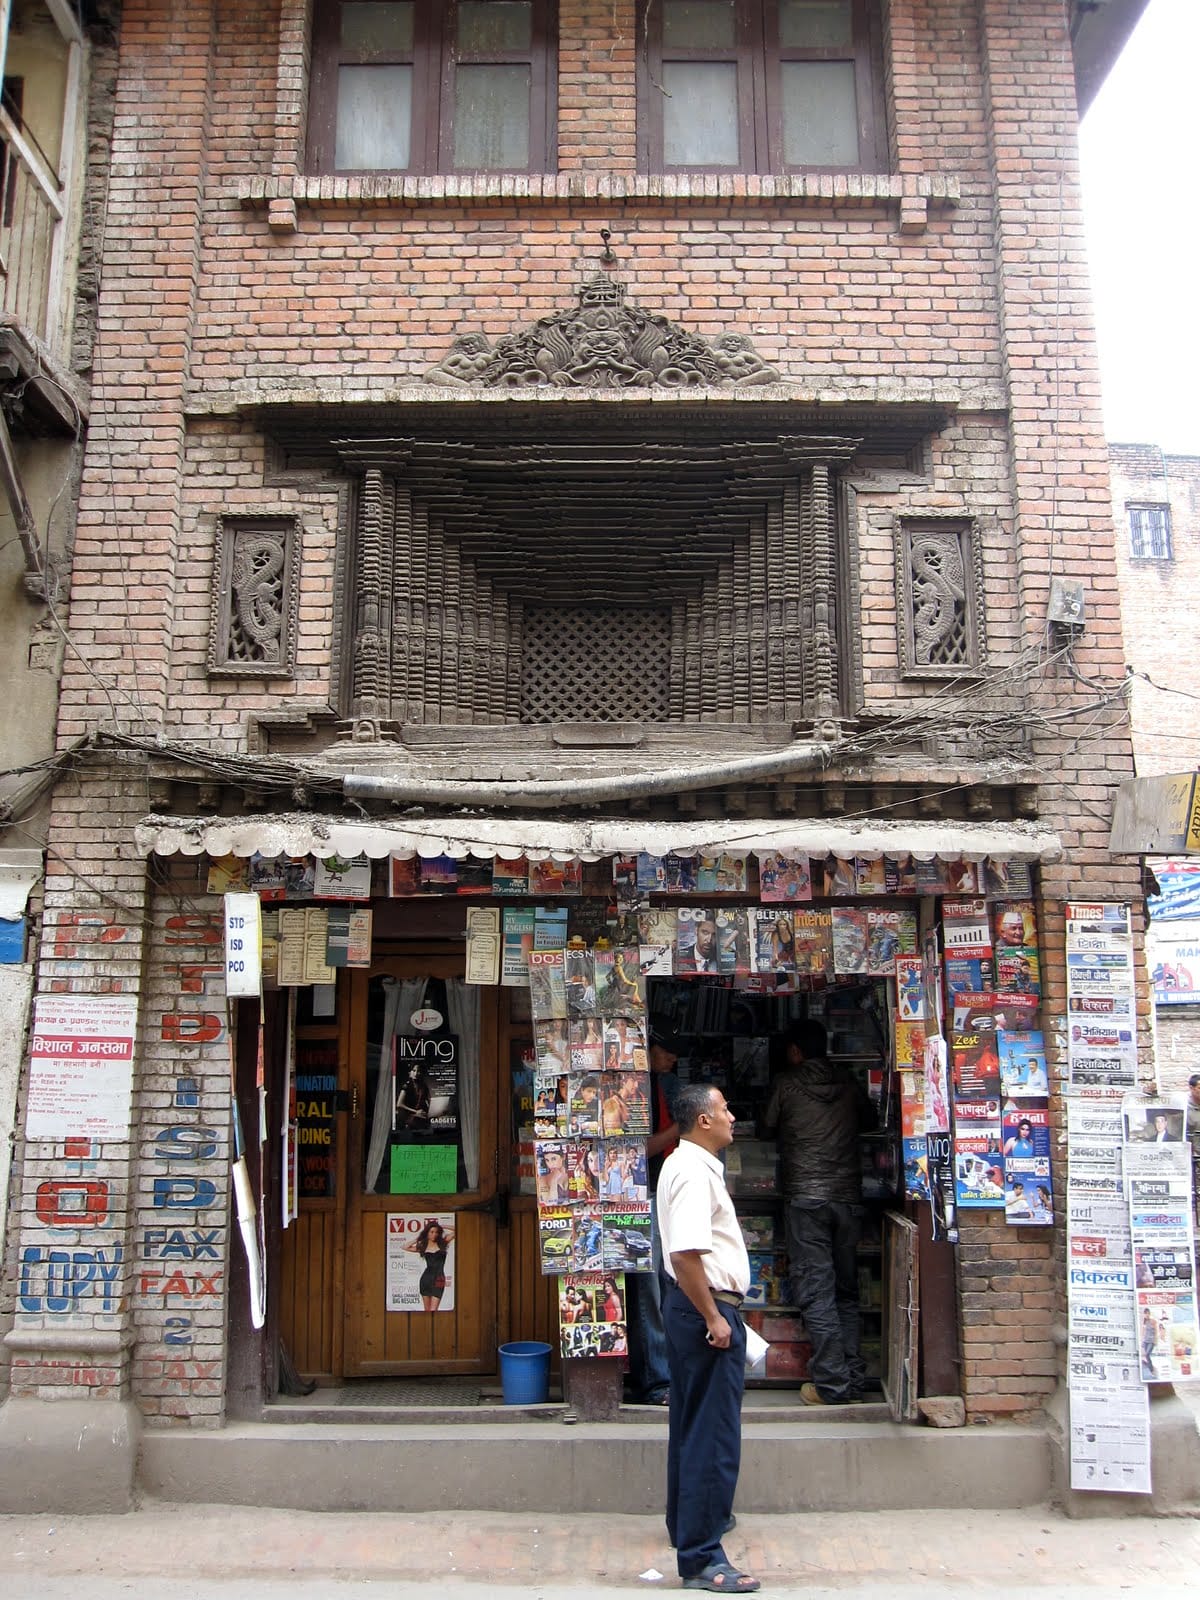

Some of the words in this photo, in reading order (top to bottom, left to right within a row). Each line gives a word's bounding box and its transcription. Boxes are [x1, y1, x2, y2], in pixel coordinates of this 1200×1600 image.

[678, 909, 706, 921] GQ
[1070, 905, 1102, 920] Times
[230, 939, 244, 951] ISD
[229, 960, 245, 973] PCO
[32, 1036, 74, 1053] विशाल
[77, 1041, 129, 1055] जनसभा
[954, 1033, 979, 1046] Zest
[400, 1036, 455, 1063] living
[603, 1202, 650, 1213] OVERDRIVE
[540, 1221, 567, 1230] FORD
[143, 1230, 221, 1258] FAX
[20, 1240, 124, 1312] COPY
[140, 1270, 223, 1299] FAX
[1071, 1269, 1128, 1286] विकल्प
[164, 1317, 193, 1345] 2
[142, 1356, 218, 1391] FAX
